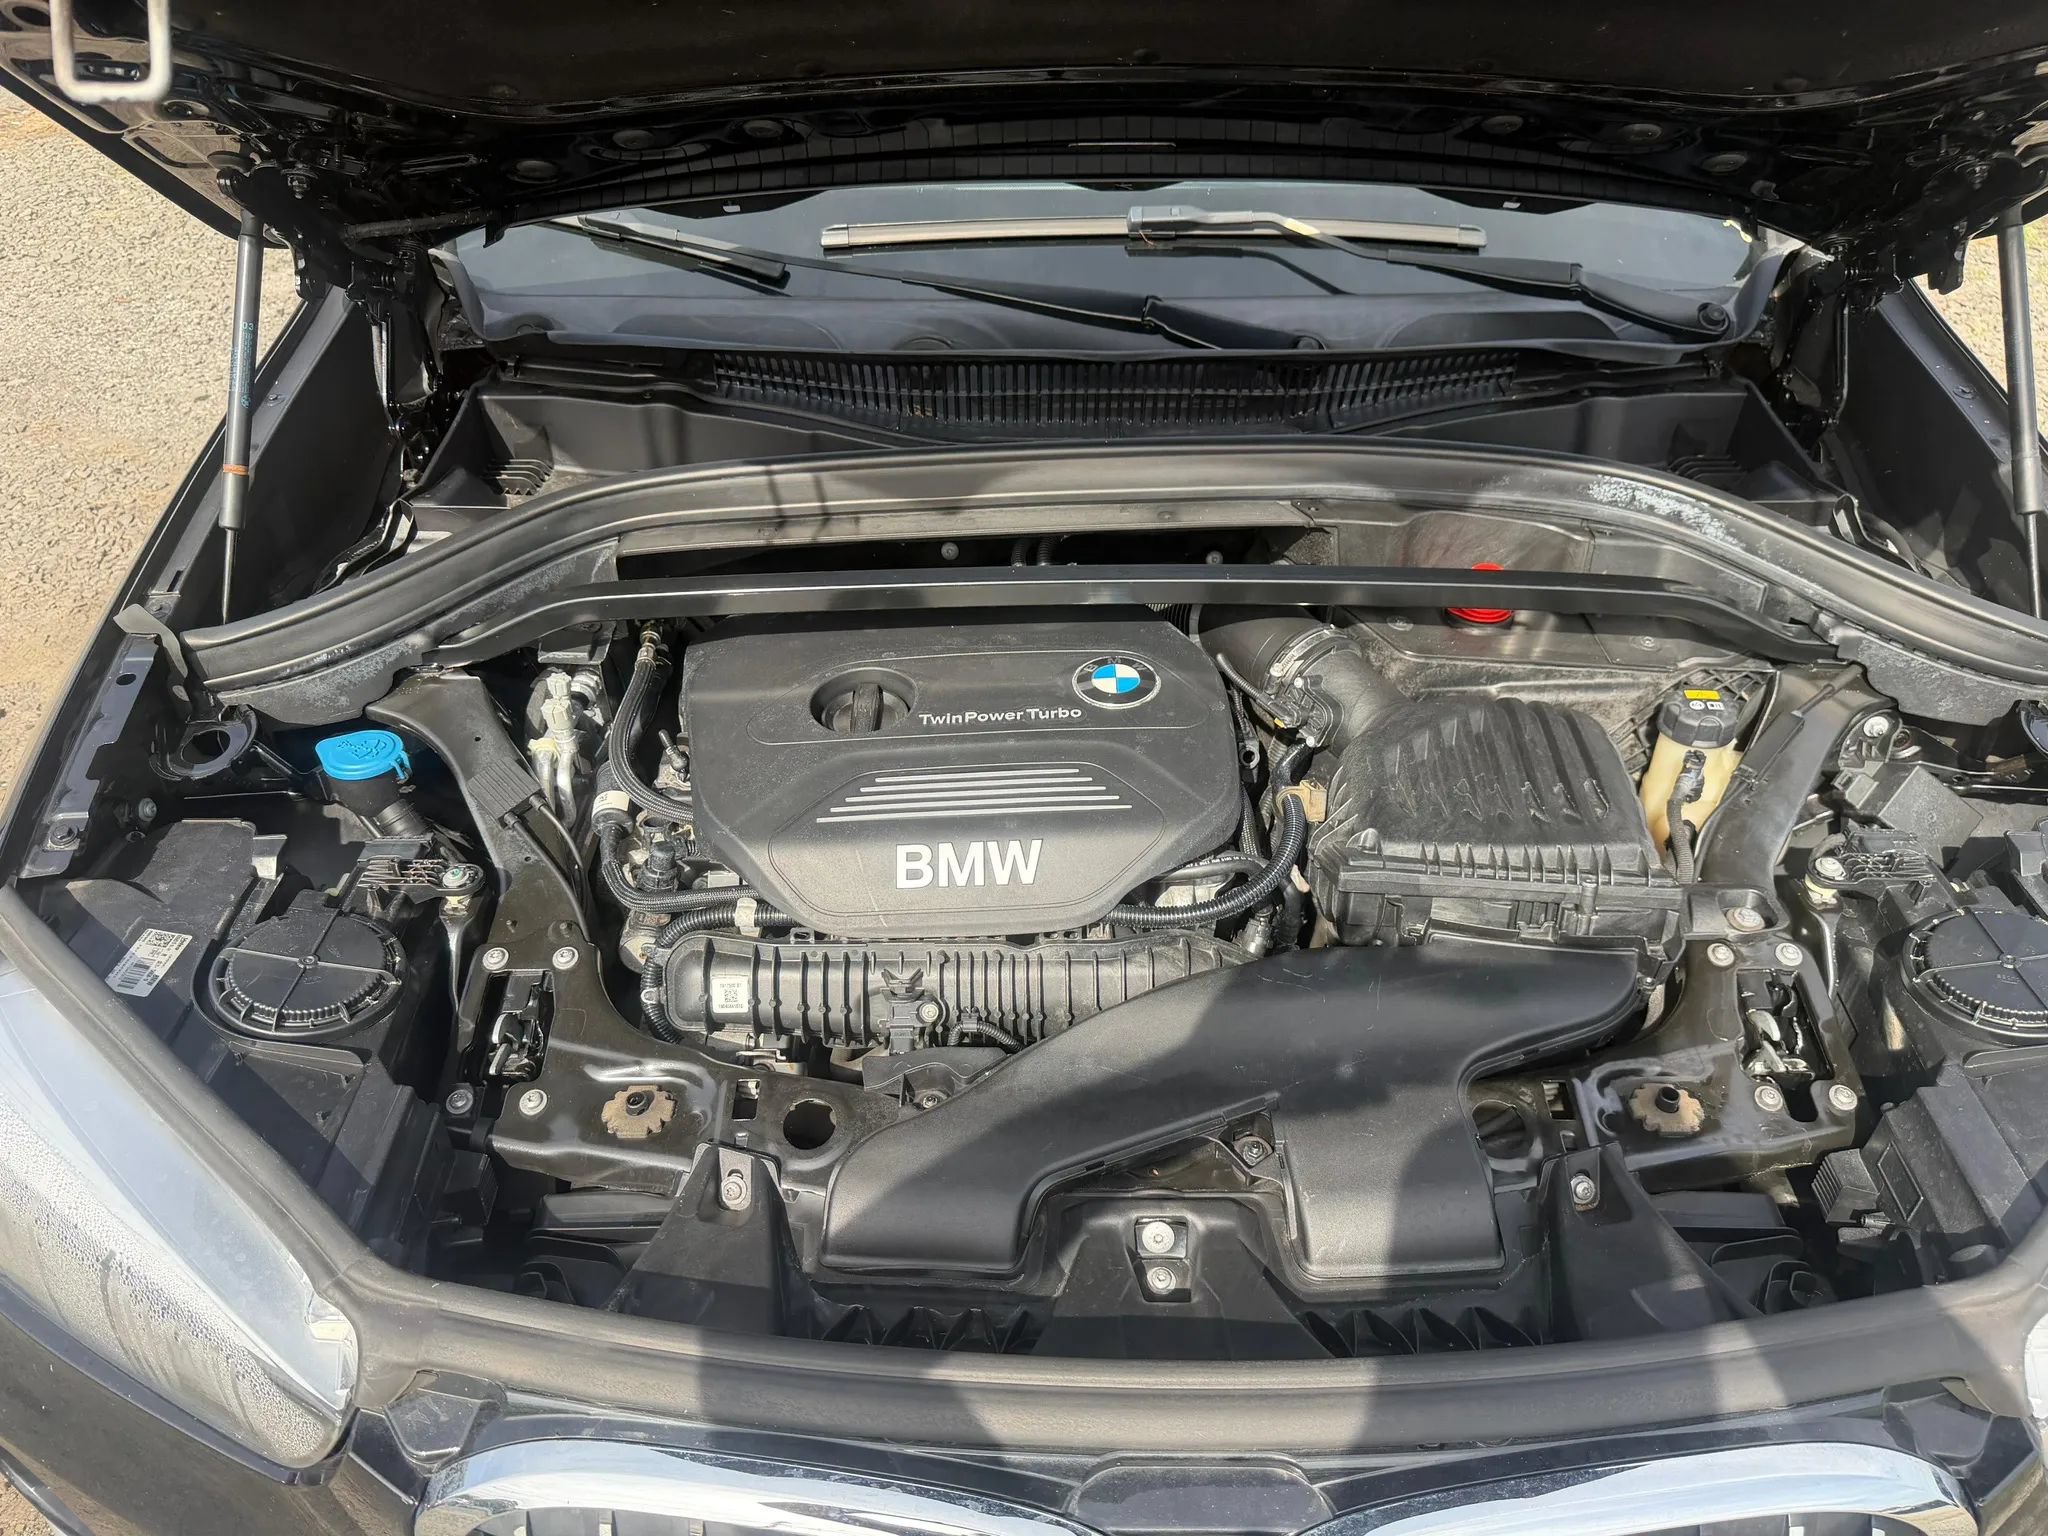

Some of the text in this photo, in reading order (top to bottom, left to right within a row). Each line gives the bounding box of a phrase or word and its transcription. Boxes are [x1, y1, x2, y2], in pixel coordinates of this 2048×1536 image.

[1083, 656, 1147, 671] BMW
[1026, 707, 1082, 720] Turbo
[896, 839, 1043, 889] BMW
